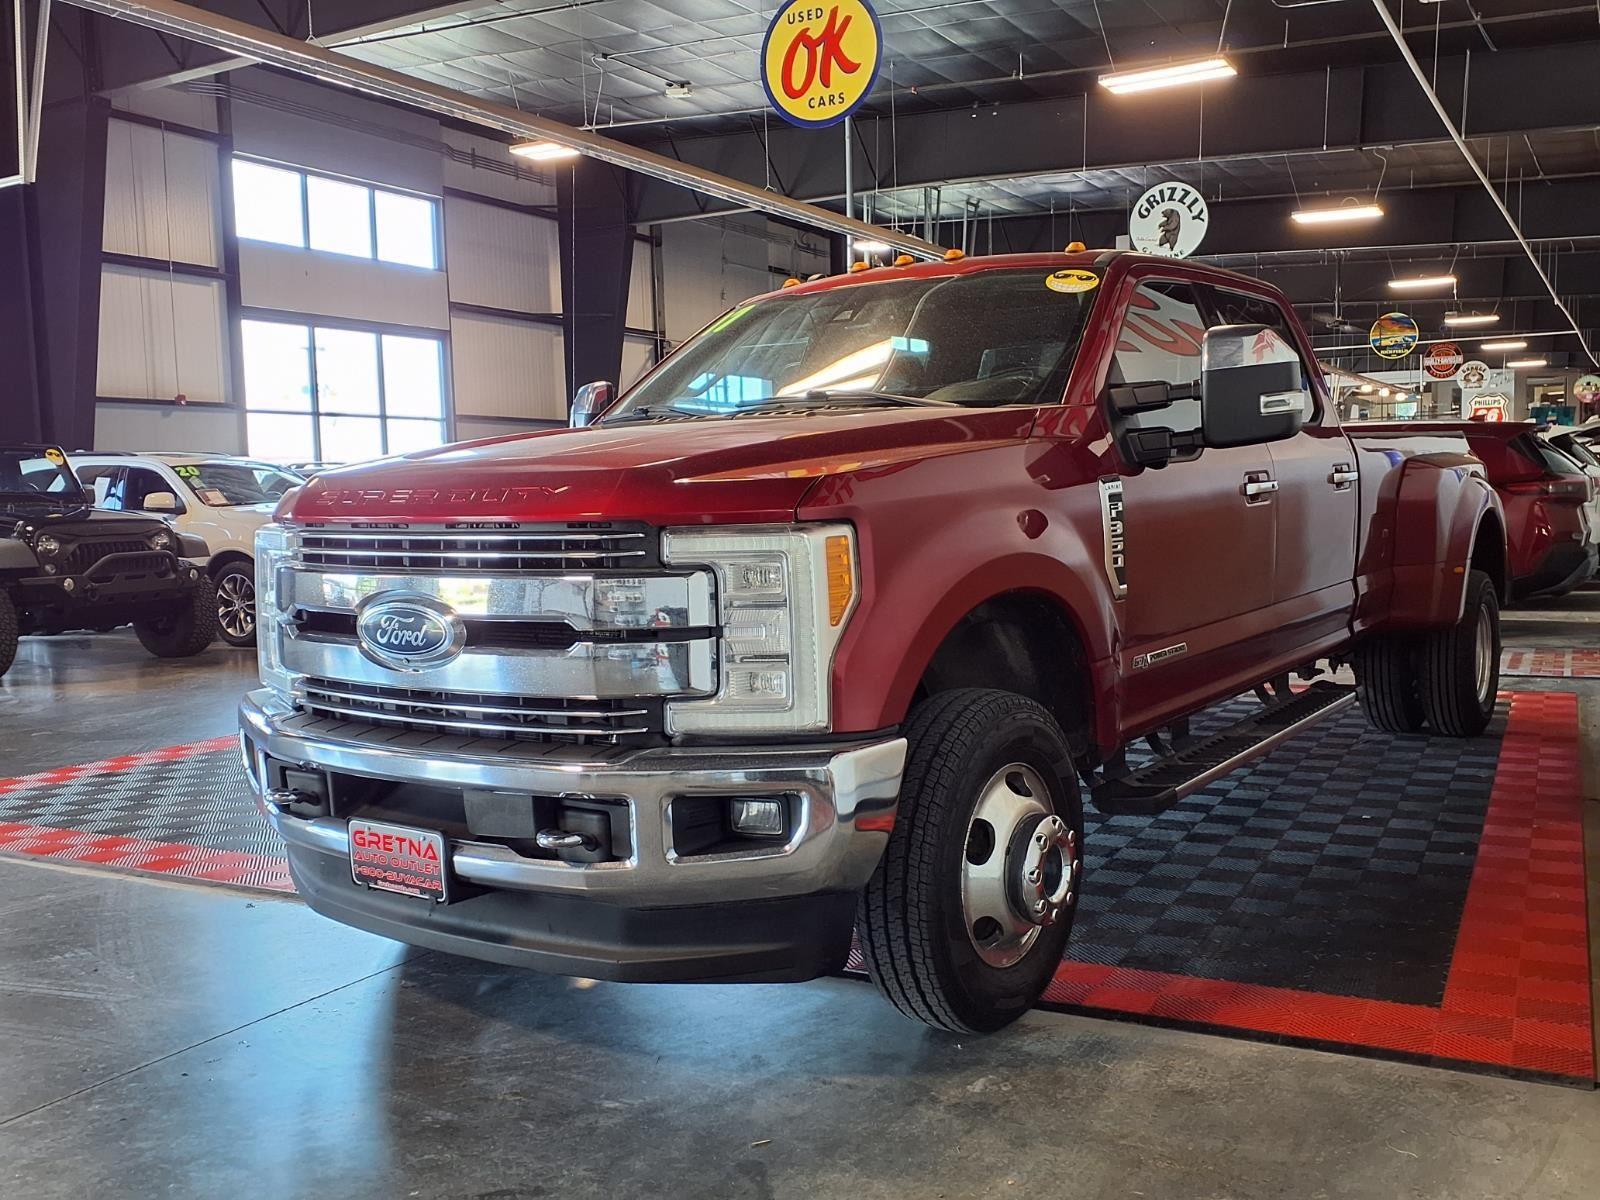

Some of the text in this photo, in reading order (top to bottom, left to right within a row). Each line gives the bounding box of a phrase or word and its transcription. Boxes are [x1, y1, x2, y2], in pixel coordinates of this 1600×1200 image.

[787, 7, 824, 25] USED
[781, 5, 862, 100] OK
[808, 91, 845, 109] CARS
[1137, 186, 1205, 223] GRIZZLY
[174, 465, 201, 477] 20
[316, 485, 572, 505] SUPER DUTY
[376, 613, 428, 647] Ford
[353, 830, 439, 861] GRETNA
[354, 851, 440, 876] AUTO OUTLET
